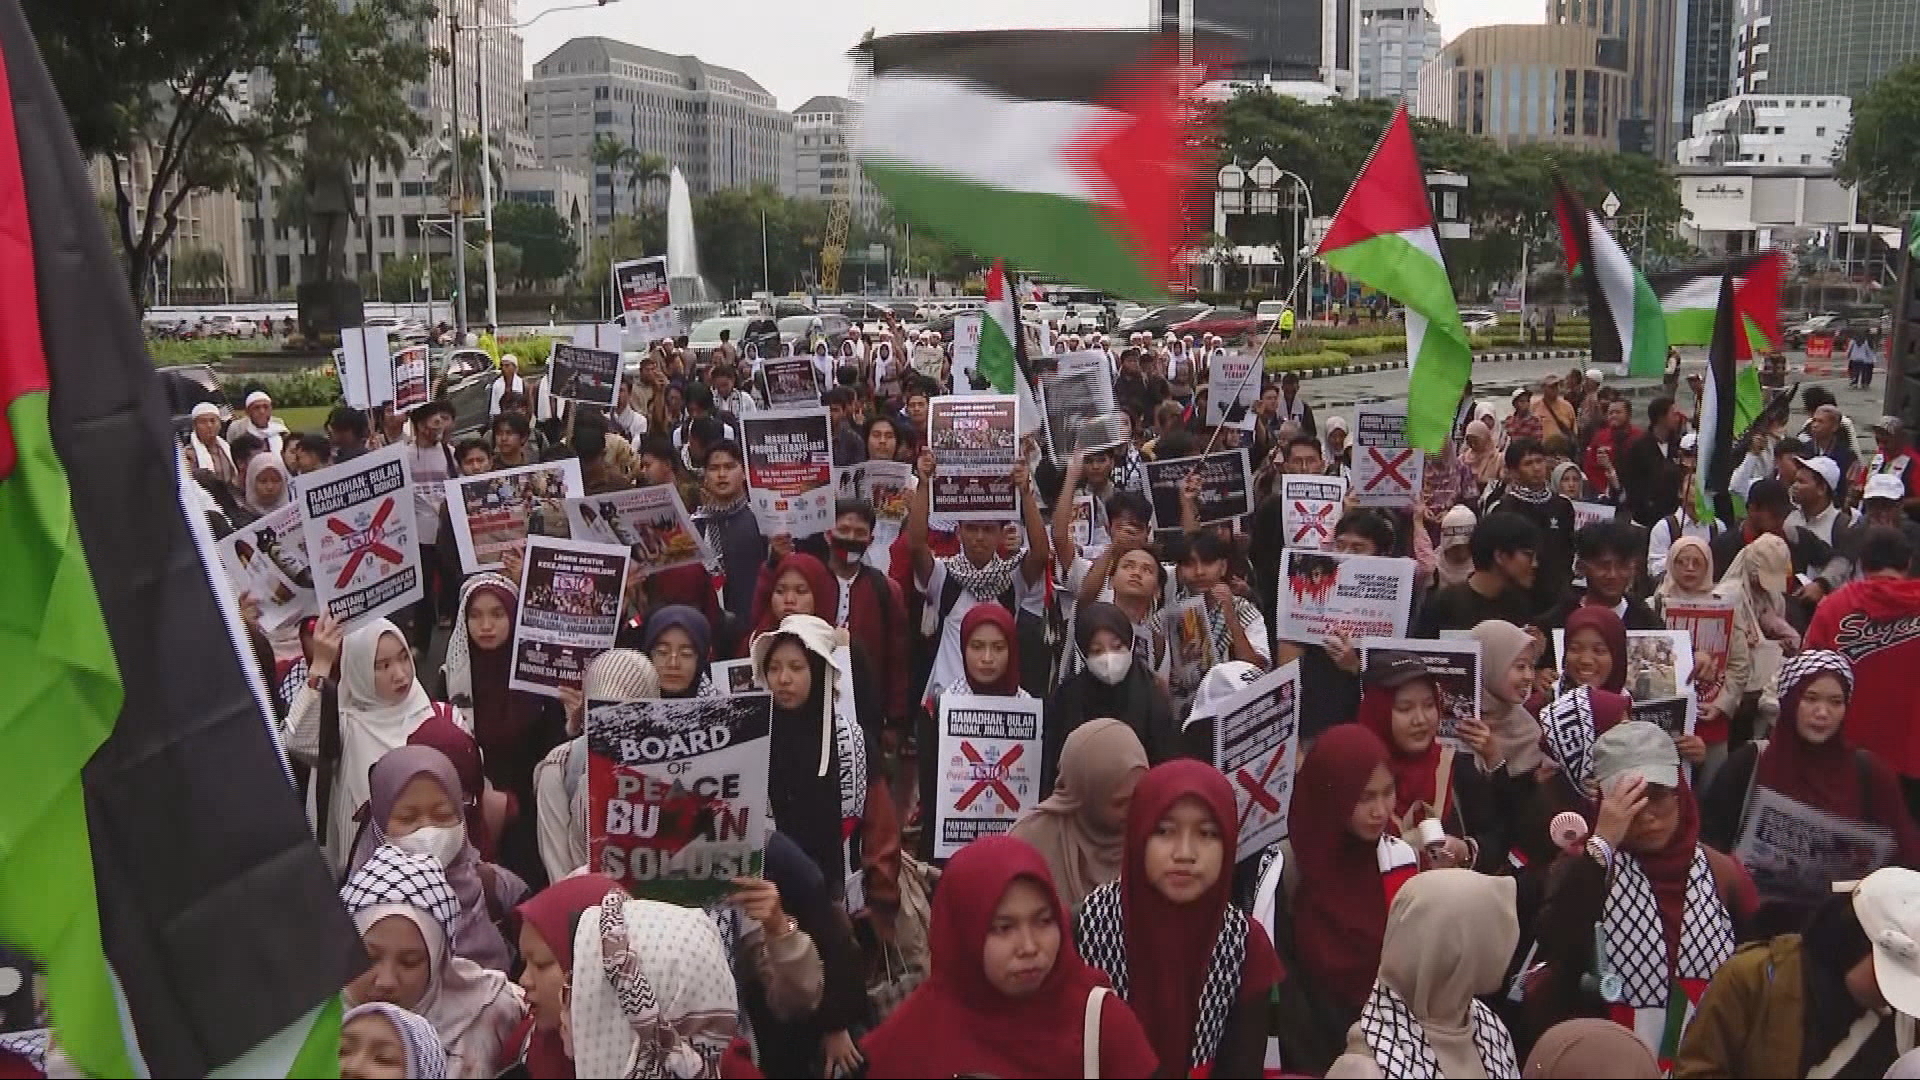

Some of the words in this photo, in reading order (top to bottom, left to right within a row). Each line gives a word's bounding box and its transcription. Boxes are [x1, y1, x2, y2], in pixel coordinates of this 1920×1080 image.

[764, 434, 790, 444] MASIH
[791, 432, 808, 443] BELI
[310, 474, 369, 504] RAMADHAN:
[369, 462, 401, 484] BULAN
[311, 495, 348, 516] IBADAH,
[348, 487, 374, 505] JIHAD,
[373, 475, 402, 495] BOIKOT
[935, 495, 969, 504] INDONESIA
[971, 495, 994, 504] JANGAN
[519, 662, 557, 678] INDONESIA
[559, 670, 582, 681] JANGA
[950, 711, 1005, 725] RAMADHAN:
[1006, 714, 1035, 727] BULAN
[950, 724, 982, 737] IBADAH,
[983, 725, 1007, 738] JIHAD,
[1007, 726, 1034, 738] BOIKOT
[619, 725, 732, 761] BOARD
[667, 761, 693, 775] OF
[617, 773, 741, 801] PEACE
[946, 821, 977, 832] PANTANG
